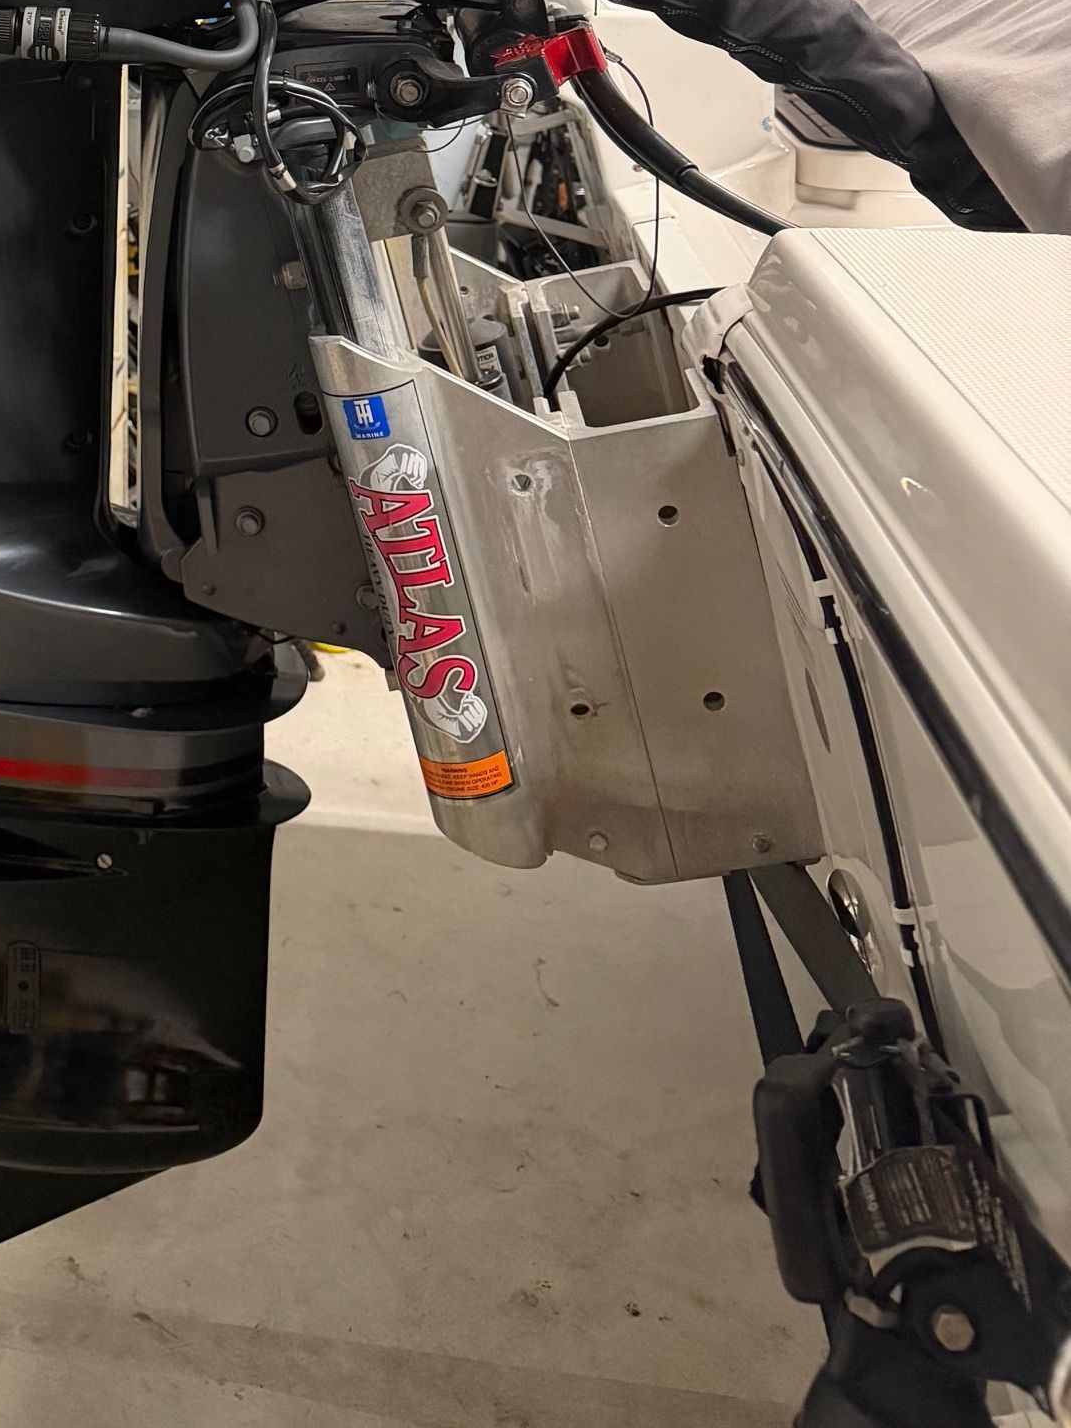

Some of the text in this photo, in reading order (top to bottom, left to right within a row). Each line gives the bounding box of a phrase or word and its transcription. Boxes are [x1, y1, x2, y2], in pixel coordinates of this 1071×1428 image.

[355, 431, 385, 439] MARINE
[349, 478, 476, 699] ATLAS
[363, 534, 395, 636] HEAVY DUTY
[468, 770, 488, 779] HANDS
[488, 765, 500, 773] AND
[471, 772, 502, 784] OPERATING
